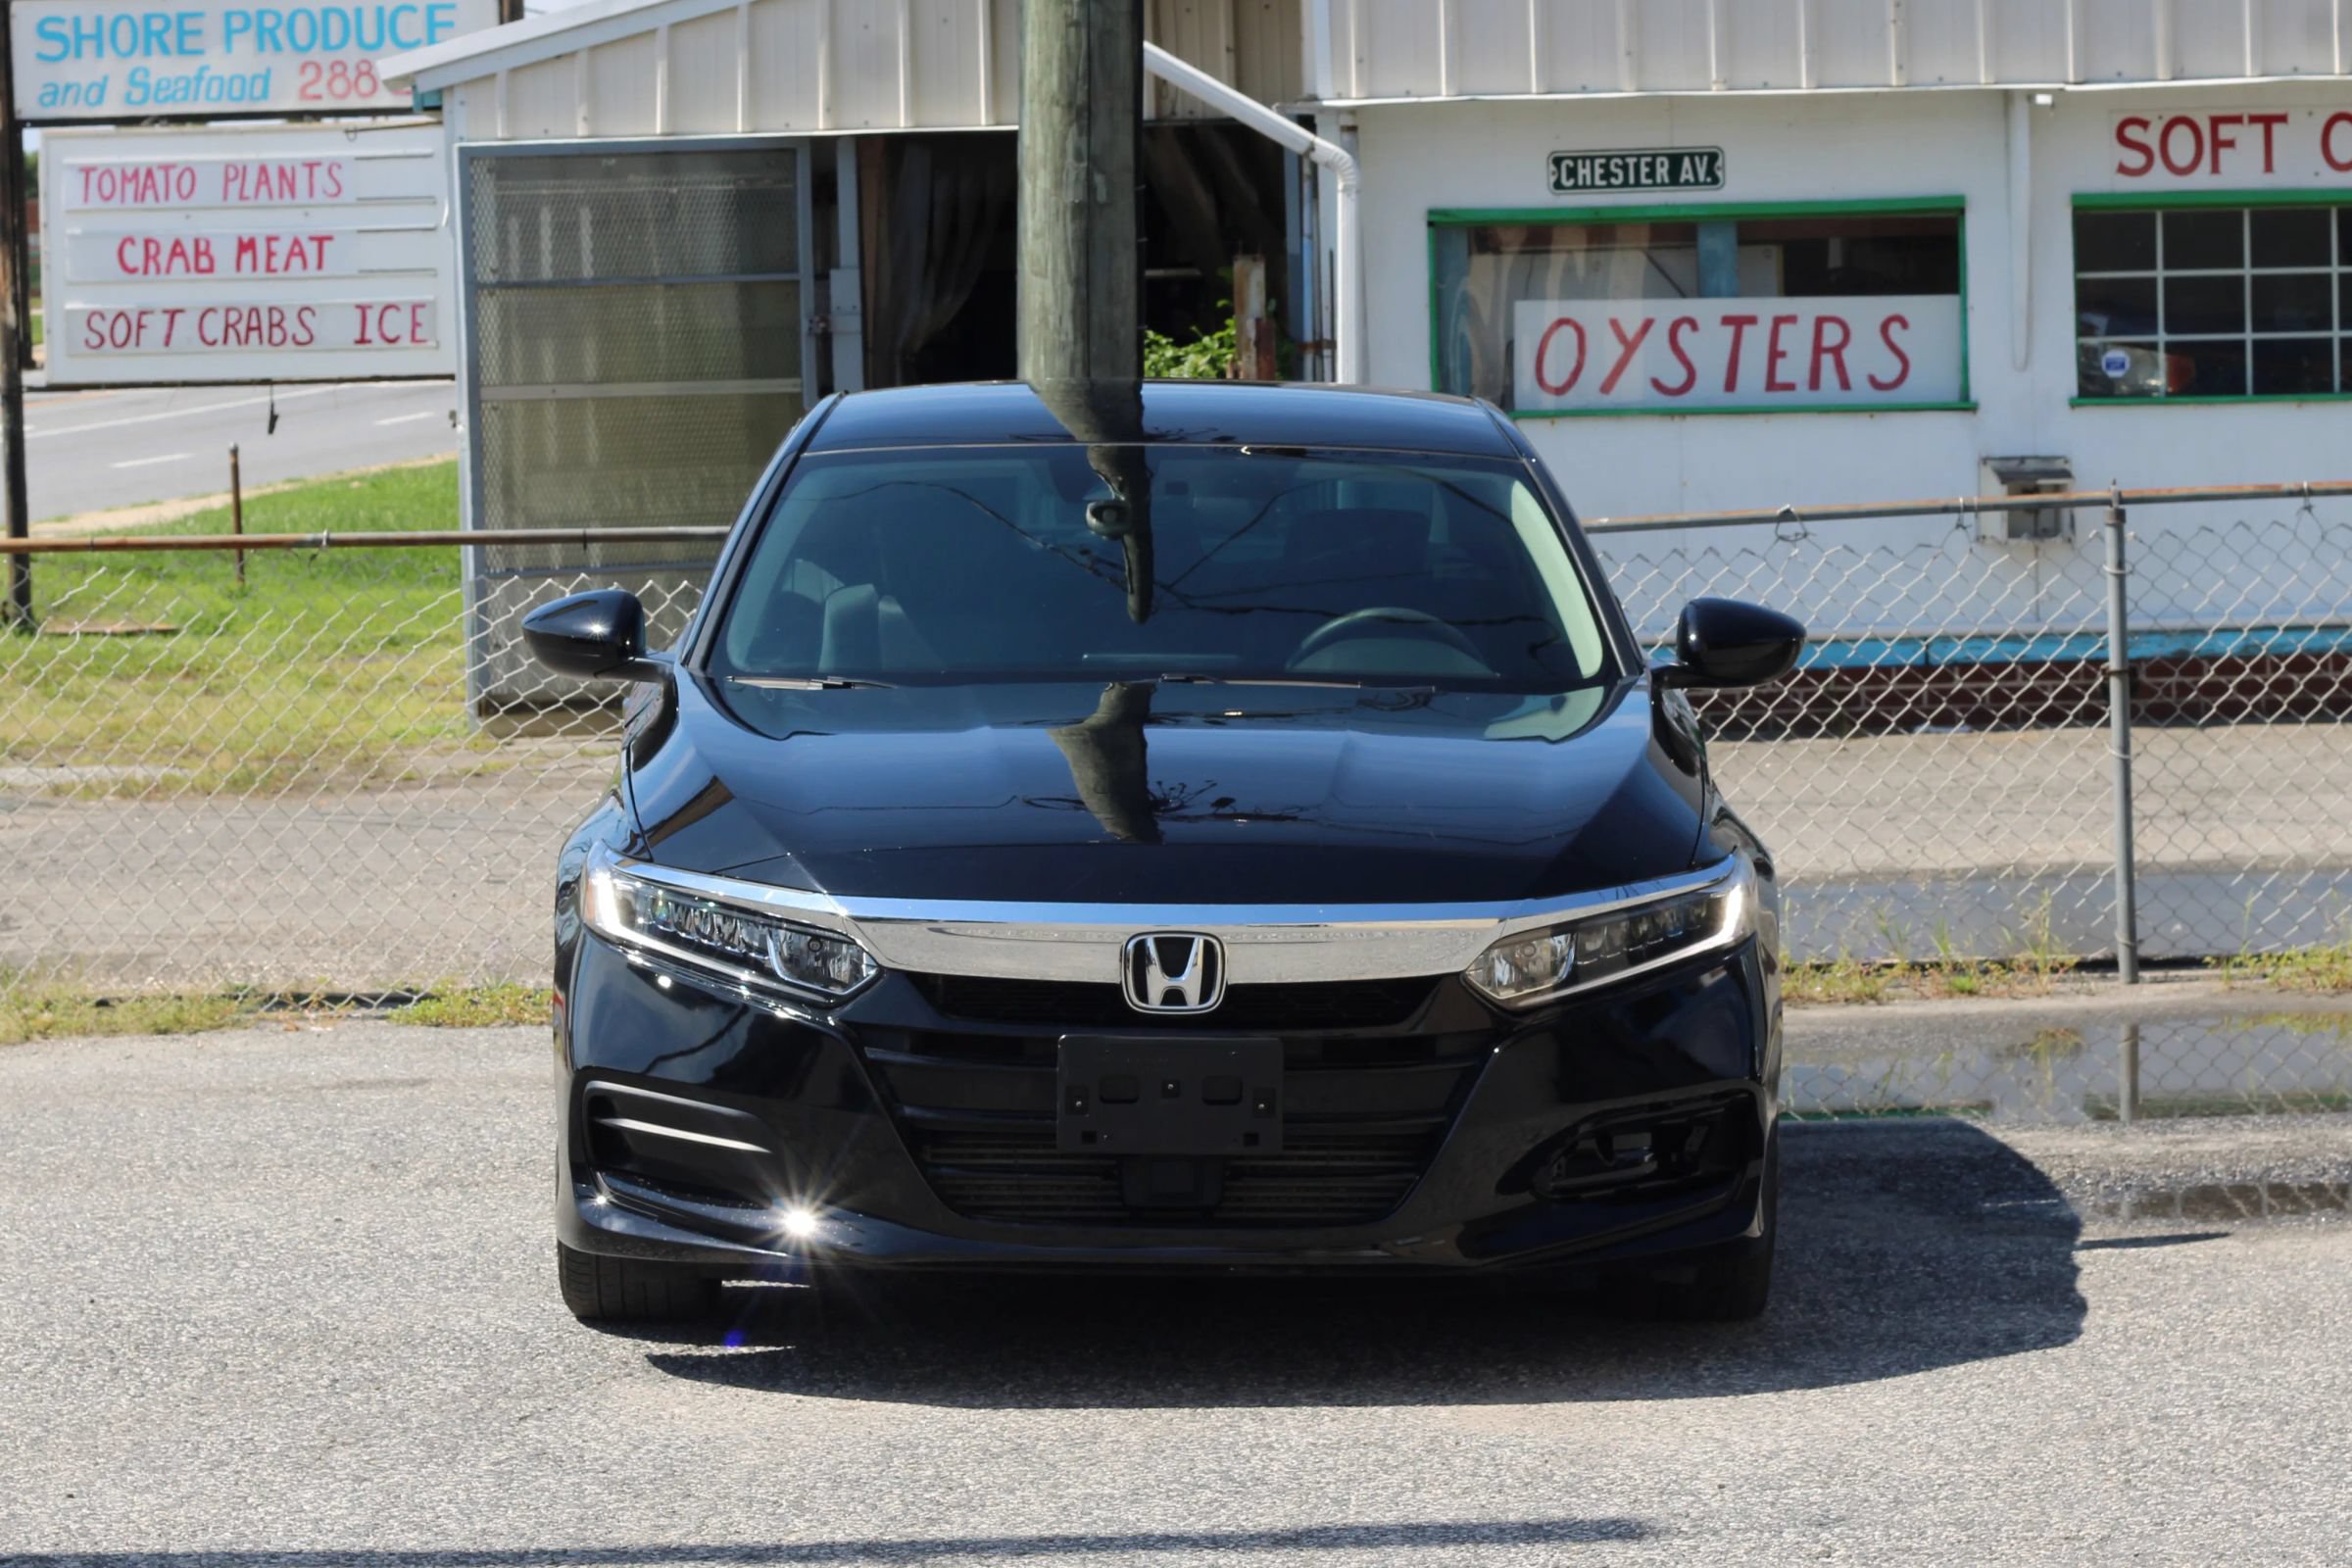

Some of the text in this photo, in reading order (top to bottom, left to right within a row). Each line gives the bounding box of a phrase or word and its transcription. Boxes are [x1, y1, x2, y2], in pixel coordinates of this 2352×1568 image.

[34, 2, 457, 64] SHORE PRODUCE
[37, 74, 111, 109] and
[123, 64, 273, 107] Seafood
[2115, 112, 2289, 177] SOFT
[79, 161, 344, 205] TOMATO PLANTS
[1560, 154, 1713, 187] CHESTER AV.
[116, 234, 335, 276] CRAB MEAT
[84, 303, 429, 350] SOFT CRABS ICE
[1535, 314, 1910, 397] OYSTERS
